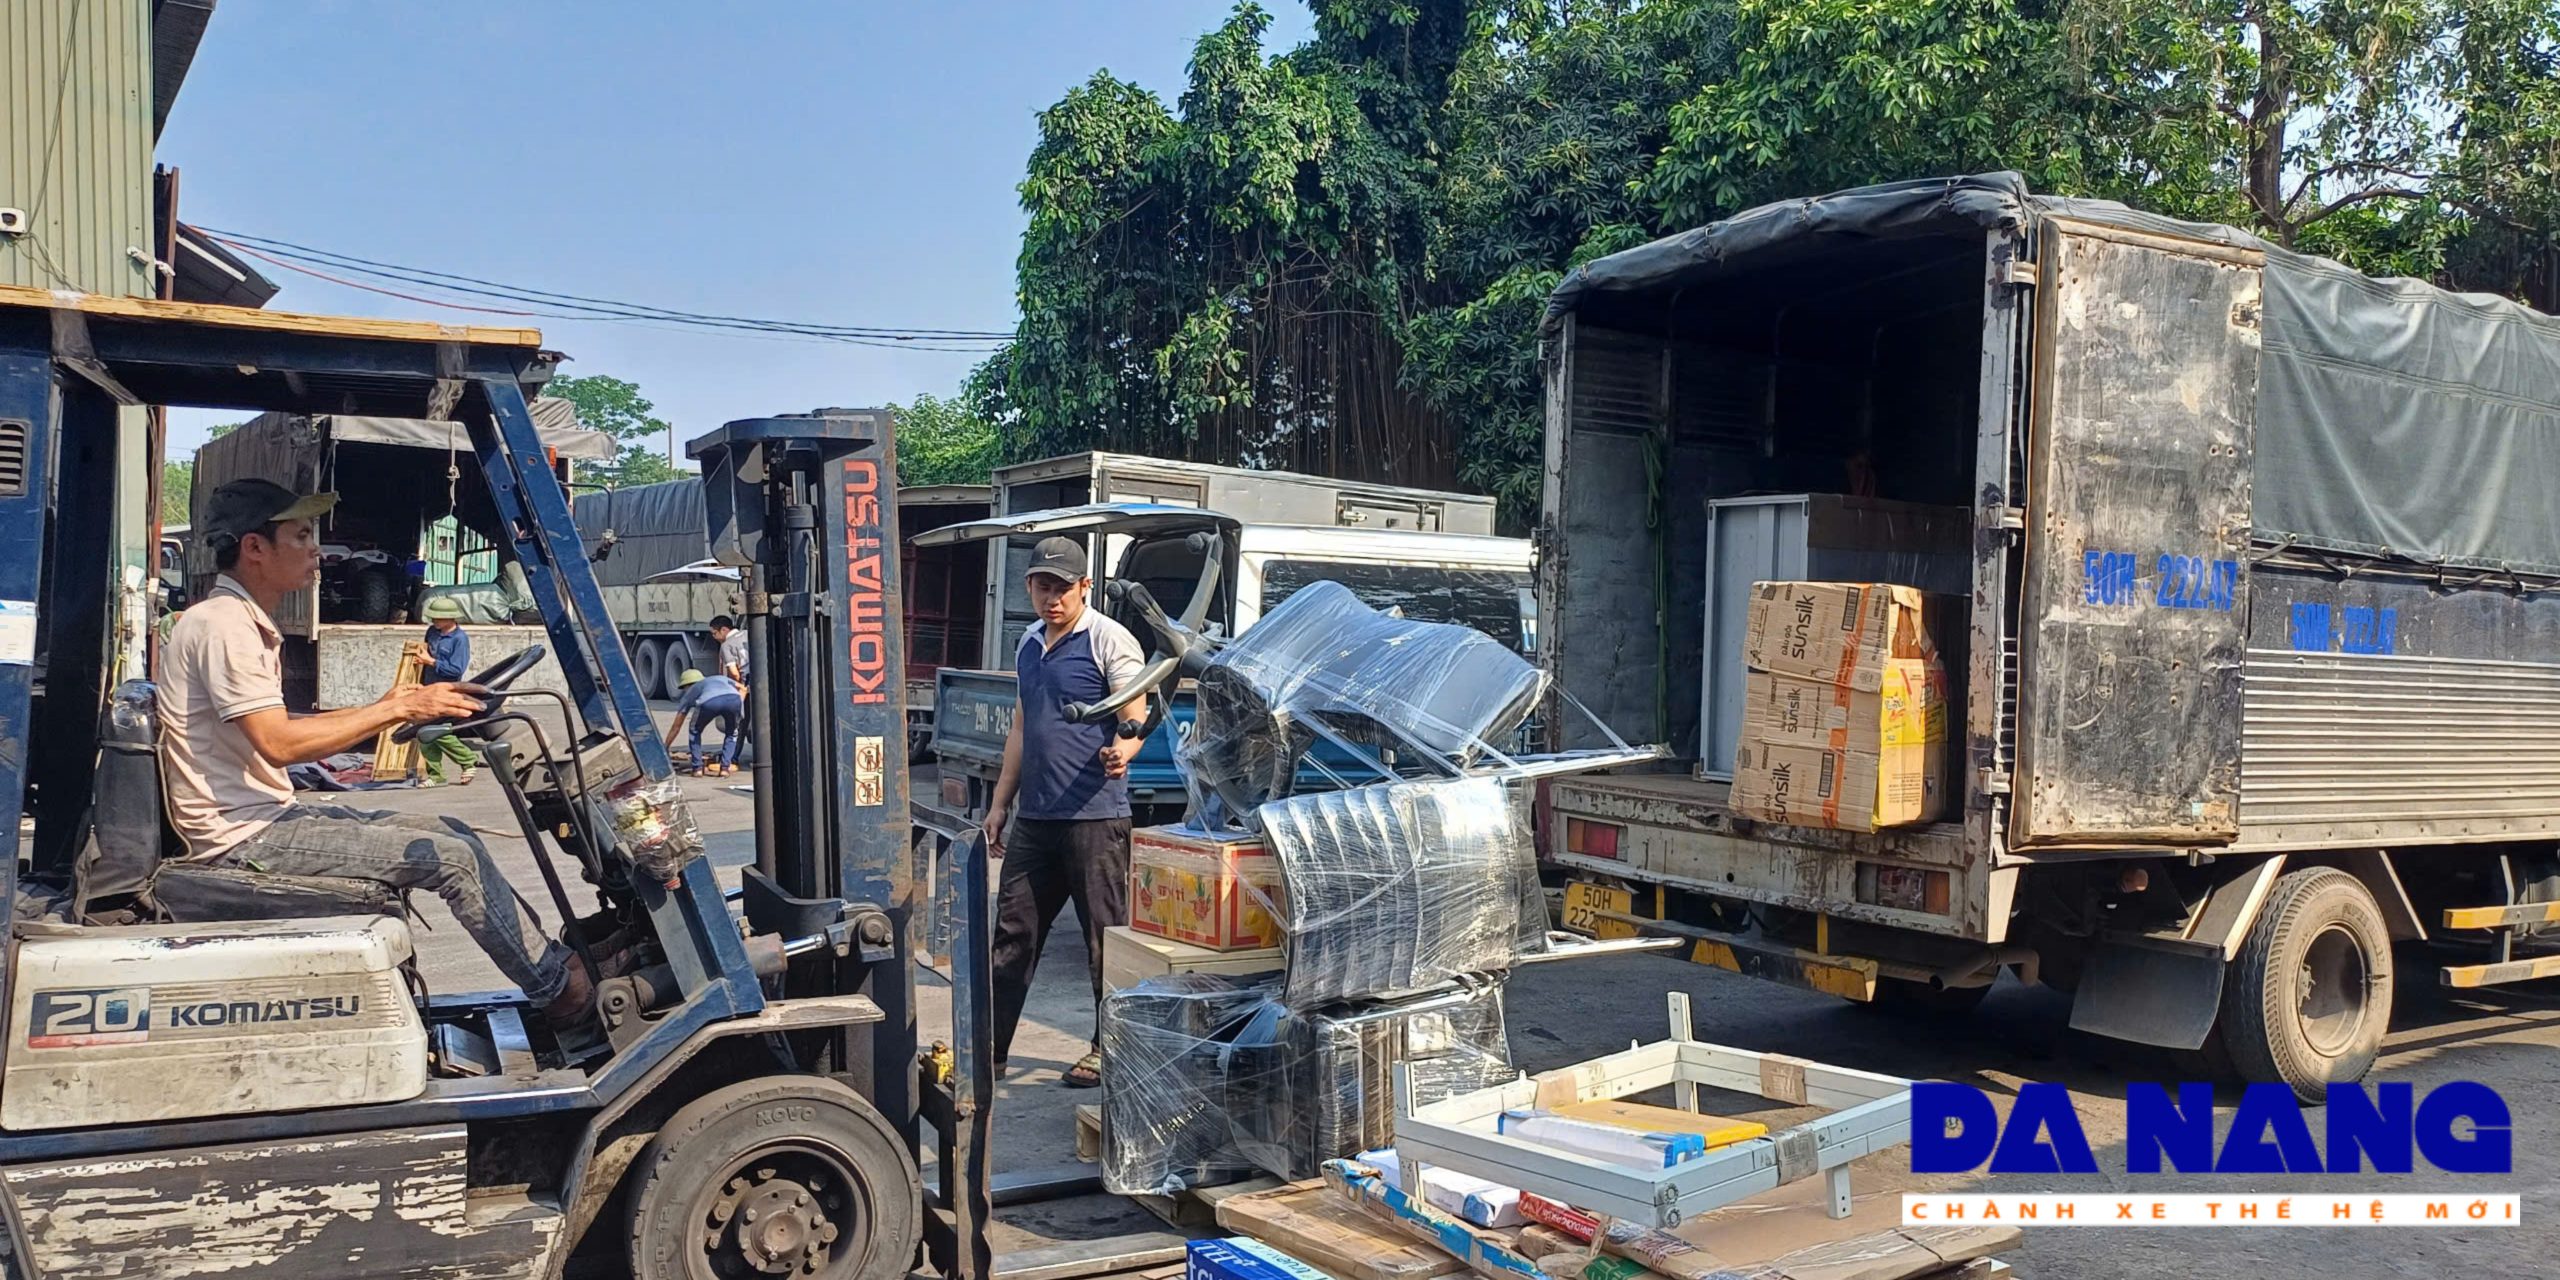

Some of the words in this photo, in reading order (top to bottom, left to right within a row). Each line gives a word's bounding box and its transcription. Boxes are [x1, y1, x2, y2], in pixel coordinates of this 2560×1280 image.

[844, 461, 885, 704] KOMATSU
[1792, 594, 1816, 660] sunsilk
[1787, 688, 1802, 733] sunsilk
[1771, 762, 1792, 824] sunsilk
[1583, 887, 1611, 910] 50H
[46, 992, 140, 1035] 20
[170, 995, 360, 1028] KOMATSU
